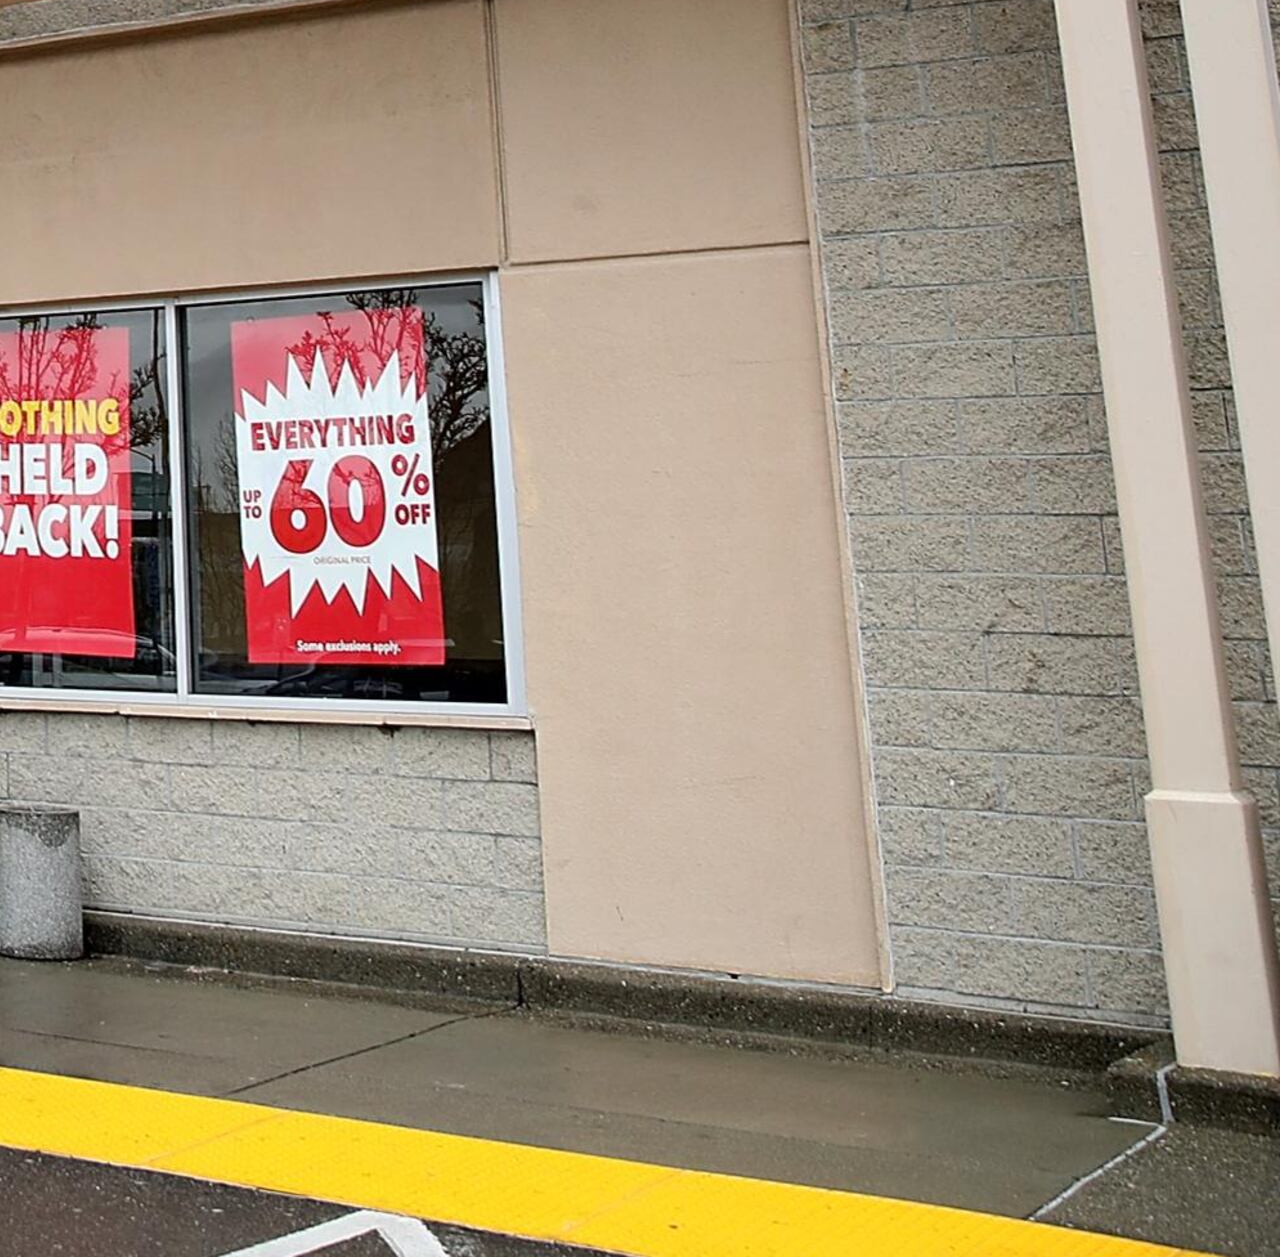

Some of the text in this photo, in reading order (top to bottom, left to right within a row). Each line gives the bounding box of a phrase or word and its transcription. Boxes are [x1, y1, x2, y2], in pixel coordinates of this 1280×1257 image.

[250, 413, 415, 451] EVERYTHING
[243, 490, 261, 503] UP
[244, 506, 262, 519] TO
[395, 504, 431, 525] OFF
[313, 556, 371, 564] ORIGINAL PRICE
[297, 640, 324, 652] Some
[325, 639, 372, 652] exclusions
